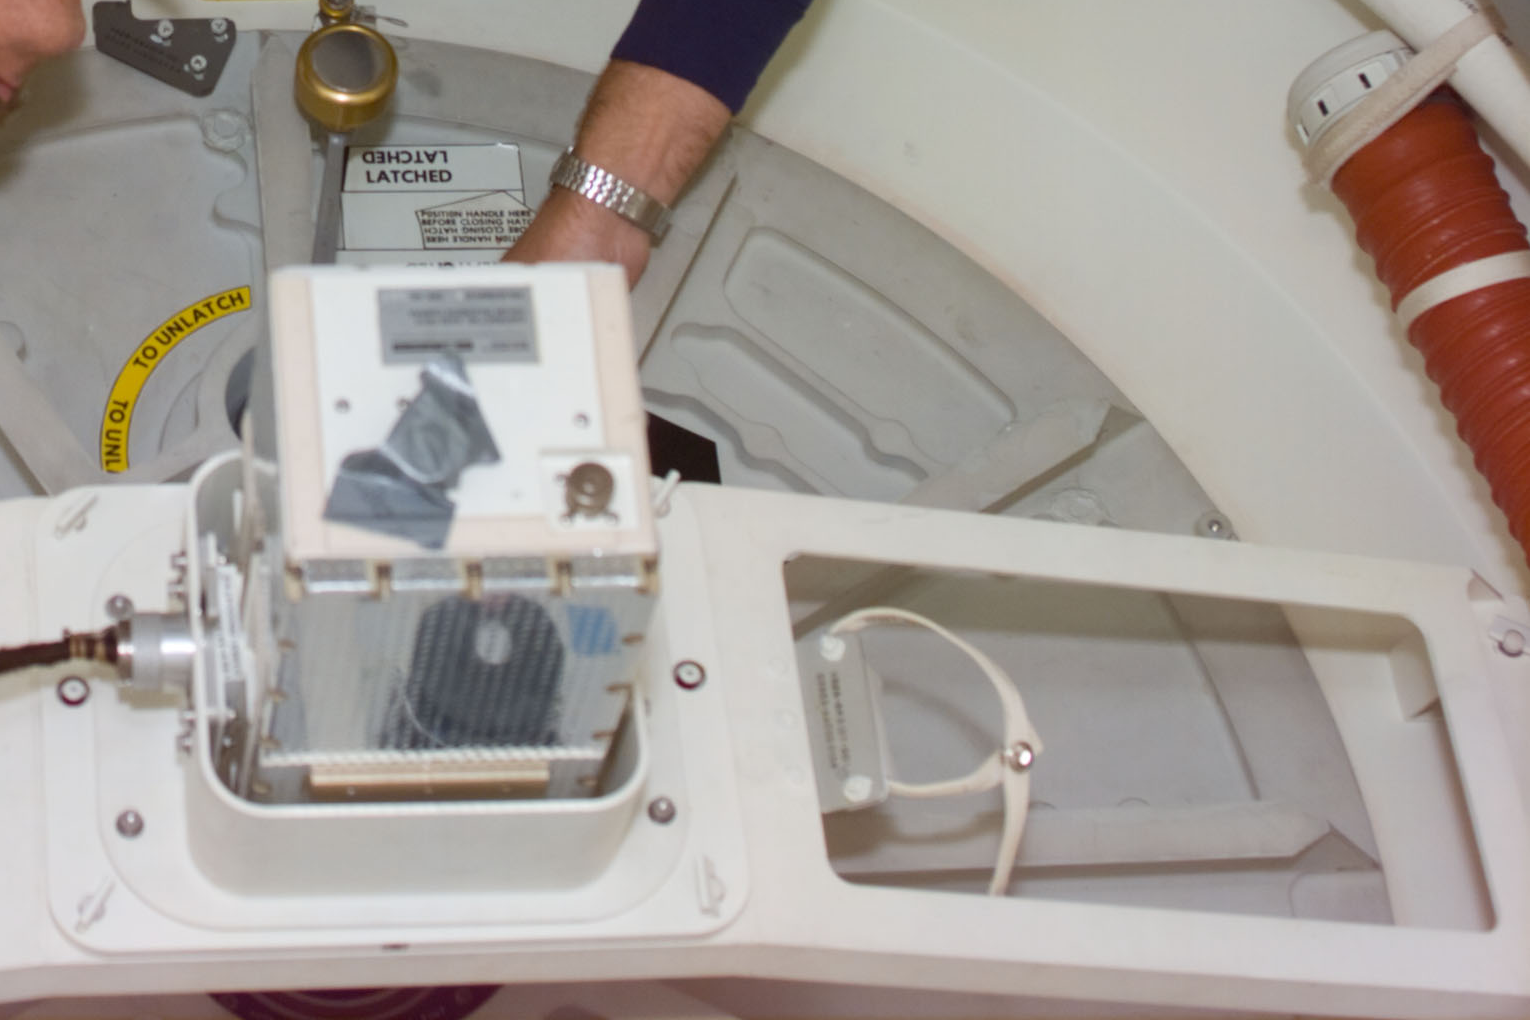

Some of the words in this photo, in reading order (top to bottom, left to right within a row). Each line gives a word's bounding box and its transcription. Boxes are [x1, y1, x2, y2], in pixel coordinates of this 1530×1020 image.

[362, 150, 448, 164] LATCHED
[366, 170, 453, 184] LATCHED
[421, 210, 462, 218] POSITION
[133, 345, 158, 370] TO
[155, 291, 245, 346] UNLATCH
[109, 399, 129, 423] TO
